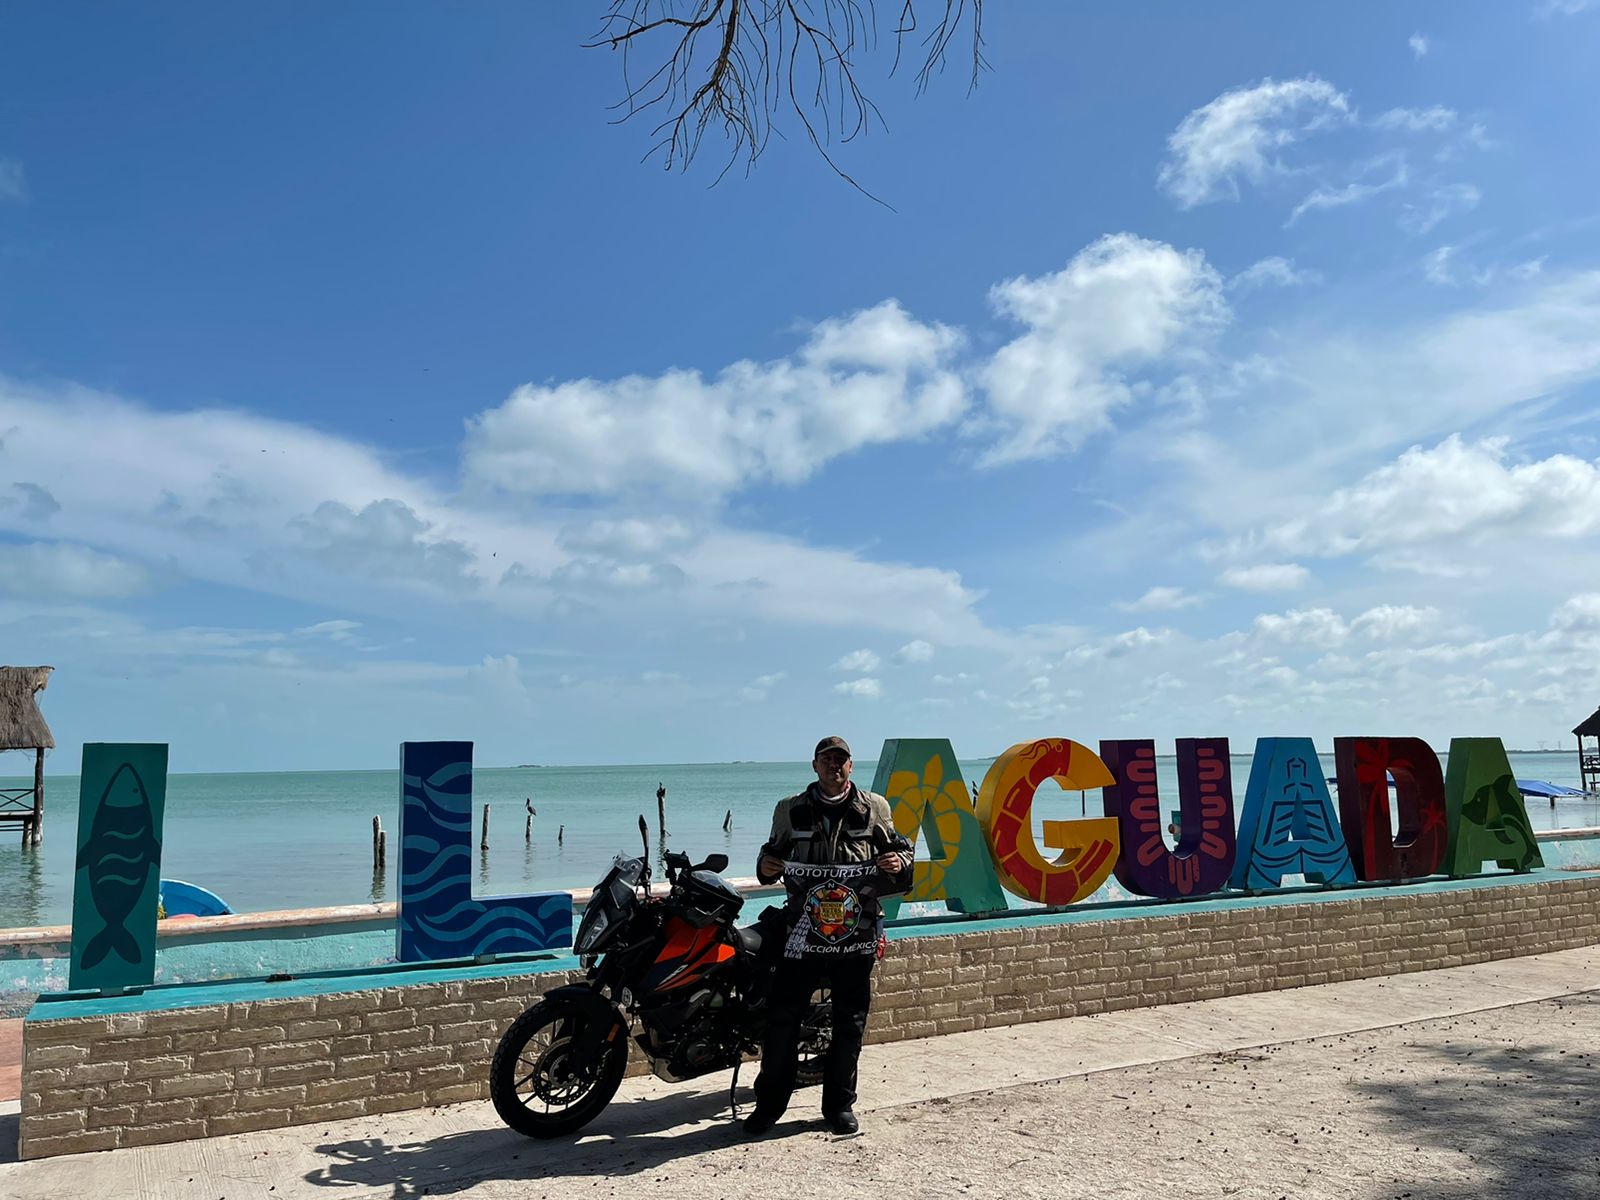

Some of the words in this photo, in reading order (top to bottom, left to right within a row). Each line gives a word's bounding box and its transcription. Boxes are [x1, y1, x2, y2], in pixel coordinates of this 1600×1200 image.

[396, 741, 573, 962] L
[878, 737, 1545, 919] AGUADA
[784, 865, 878, 878] MOTOTURISTA
